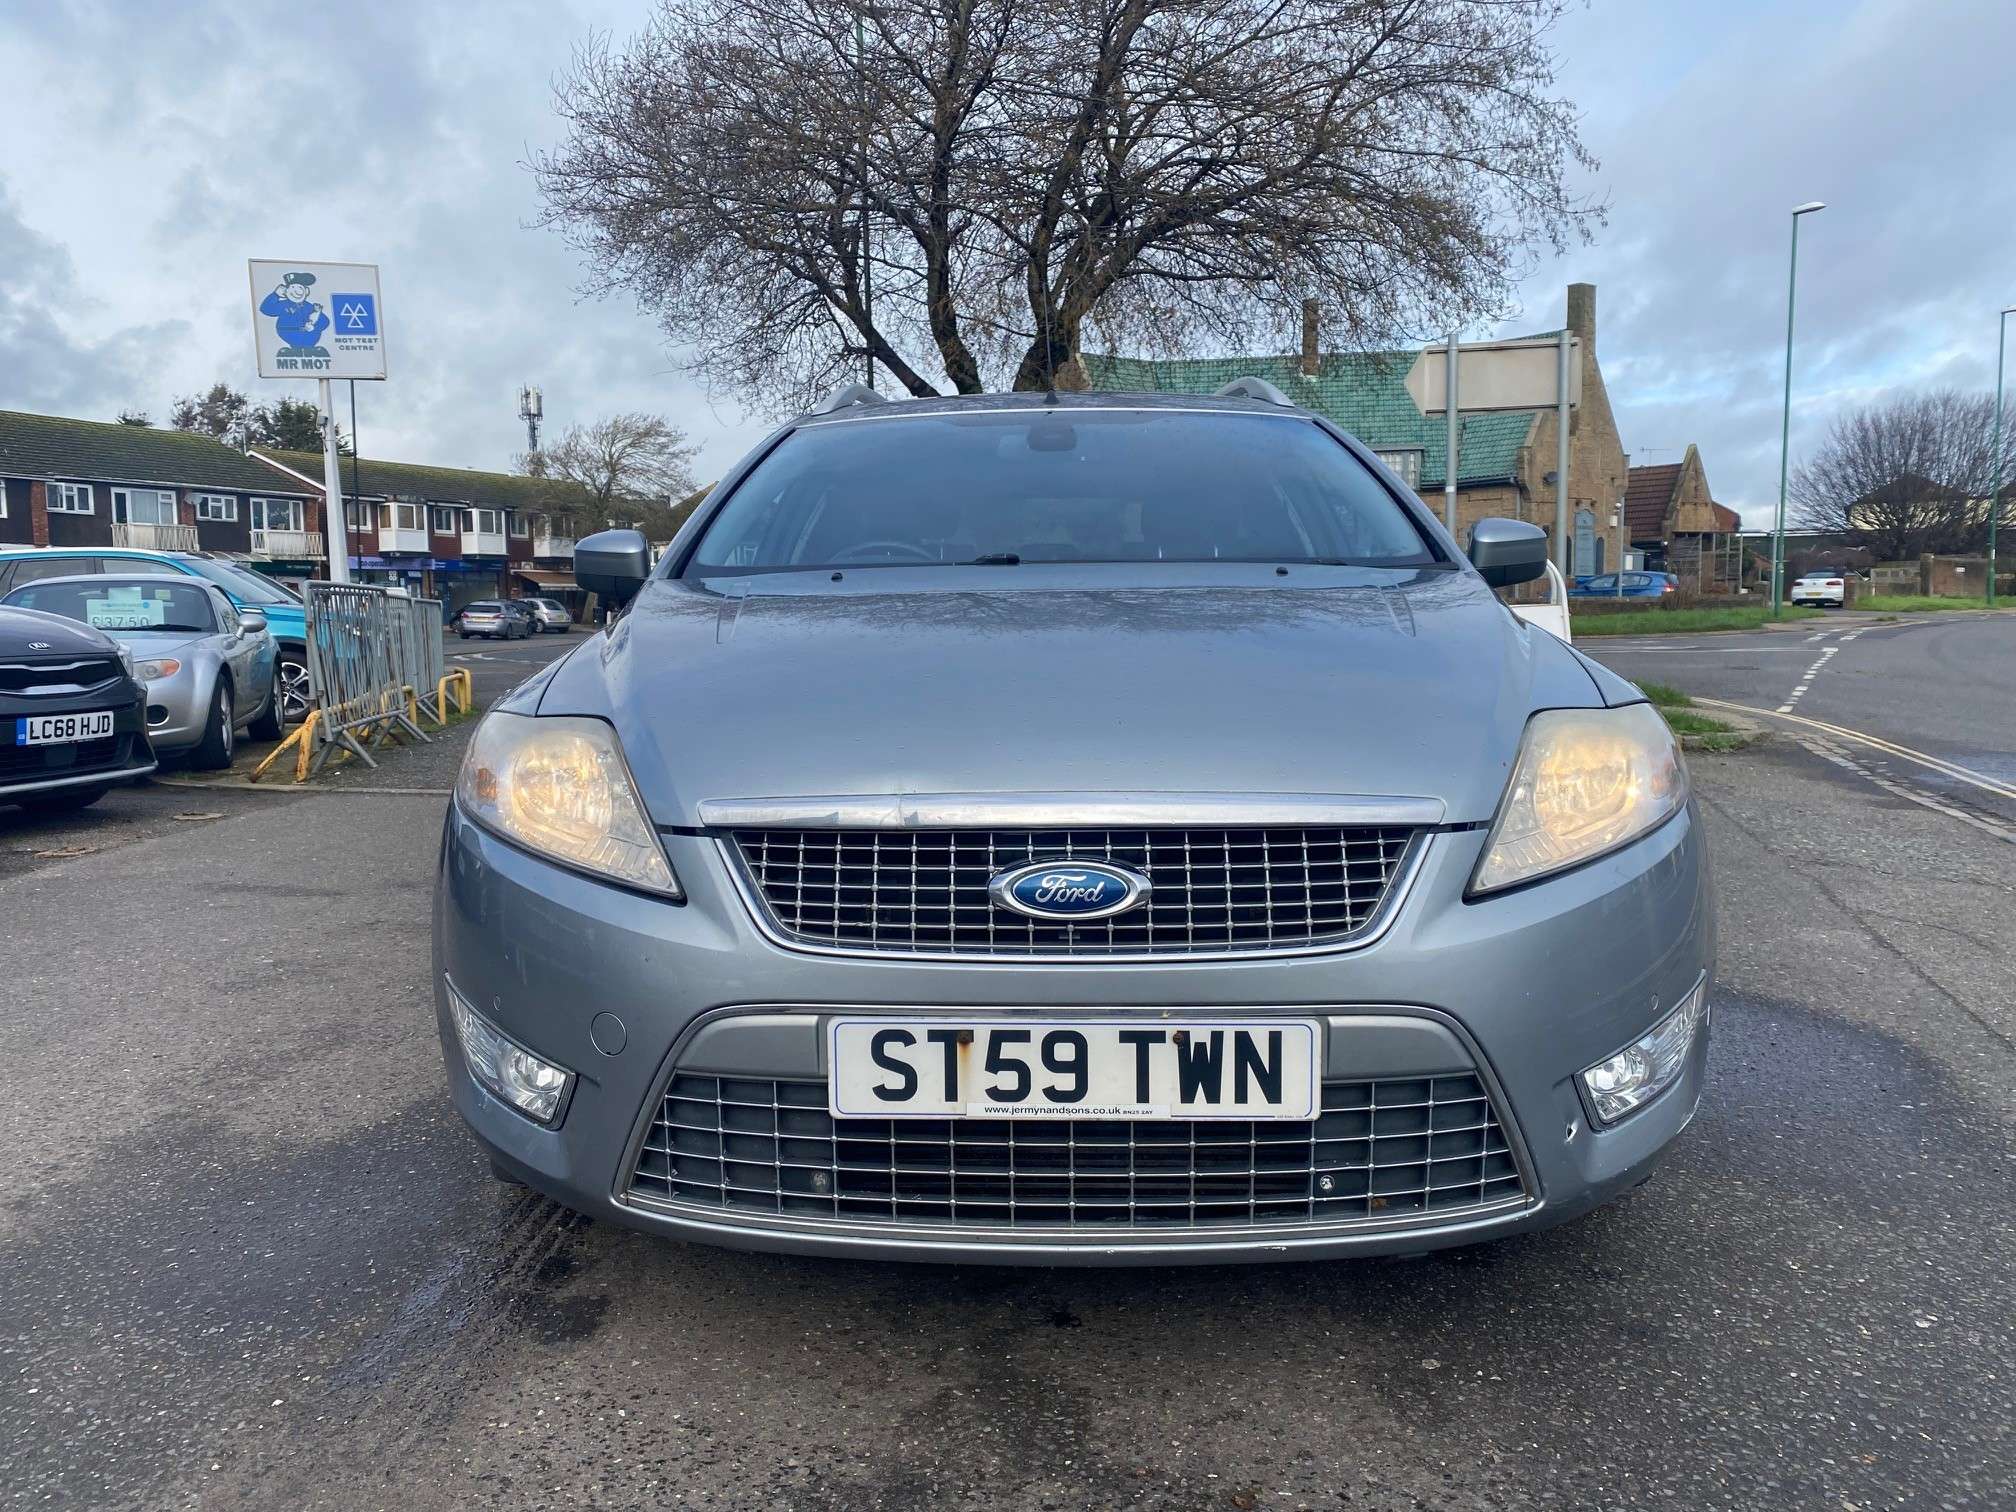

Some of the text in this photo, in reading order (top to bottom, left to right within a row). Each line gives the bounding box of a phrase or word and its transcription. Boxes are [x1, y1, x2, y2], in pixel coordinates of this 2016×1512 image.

[276, 358, 332, 370] MR MOT
[29, 715, 110, 740] LC68 HJD
[1035, 874, 1105, 903] Ford
[870, 1028, 1283, 1105] ST59 TWN
[984, 1106, 1121, 1116] www.jermynandsons.co.uk
